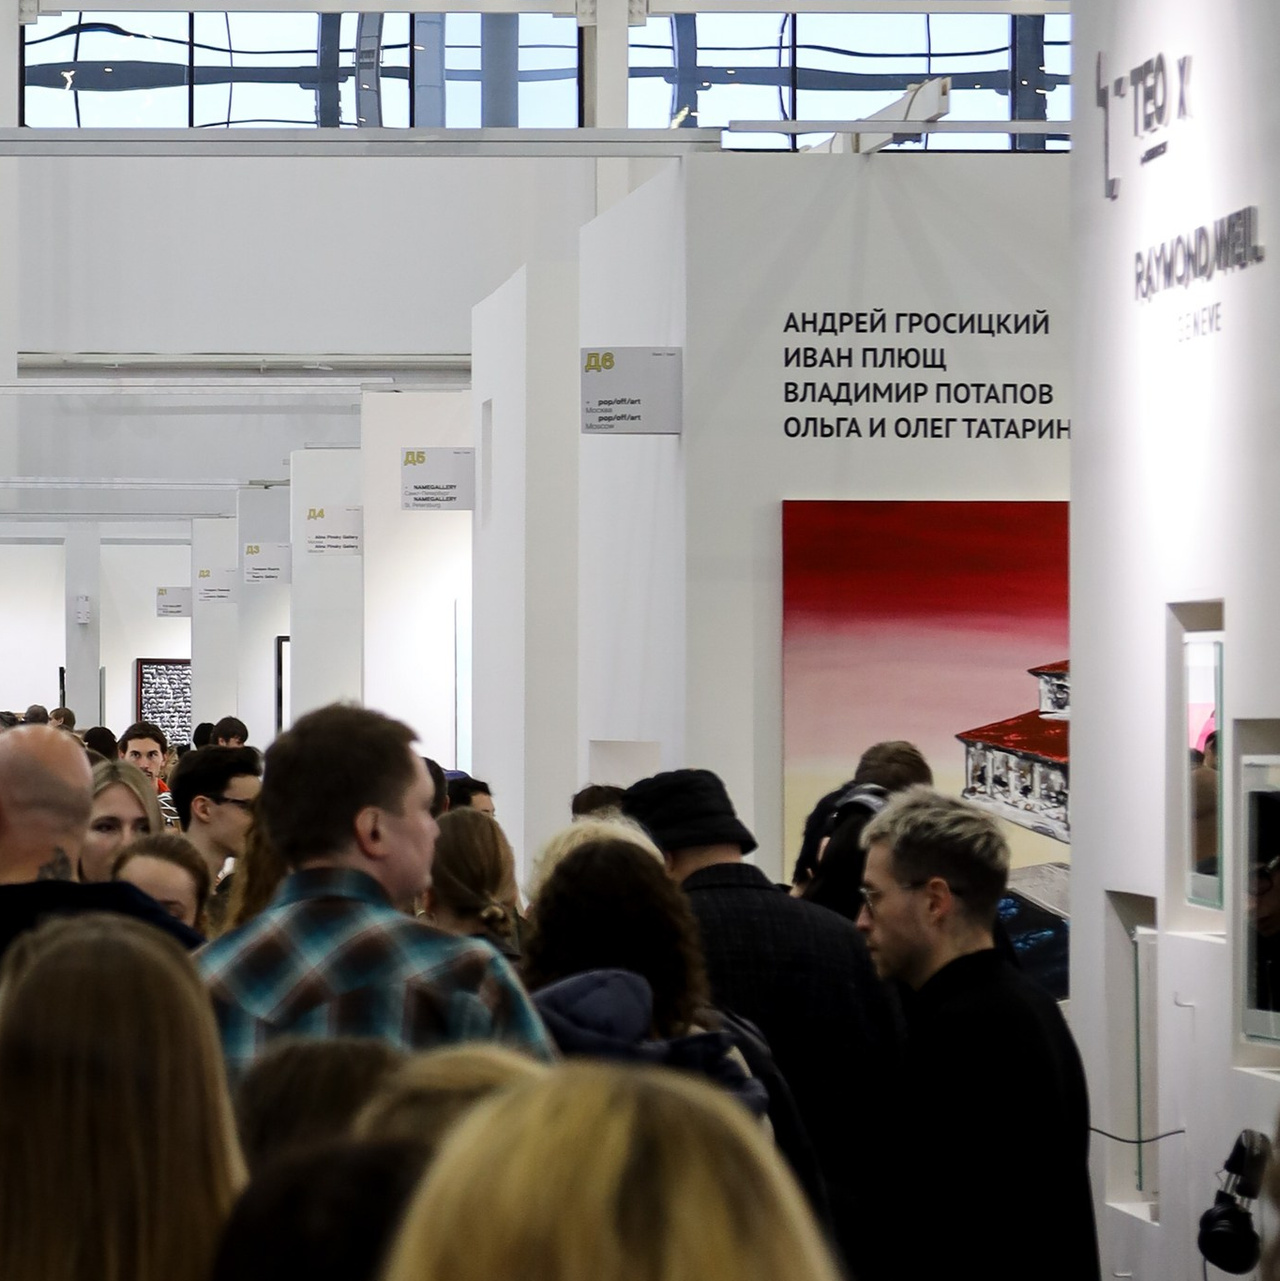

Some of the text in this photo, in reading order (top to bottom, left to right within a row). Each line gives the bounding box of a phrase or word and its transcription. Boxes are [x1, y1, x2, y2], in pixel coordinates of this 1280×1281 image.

[1135, 225, 1211, 302] RAYMOND
[783, 308, 1051, 338] АНДРЕЙ ГРОСИЦКИЙ
[585, 352, 615, 372] Д6
[783, 347, 947, 374] ИВАН ПЛЮЩ
[598, 398, 641, 406] pop/off/art
[783, 382, 1054, 408] ВЛАДИМИР ПОТАПОВ
[598, 414, 641, 422] pop/off/art
[783, 417, 1071, 439] ОЛЬГА И ОЛЕГ ТАТАРИН
[404, 451, 426, 466] Д5
